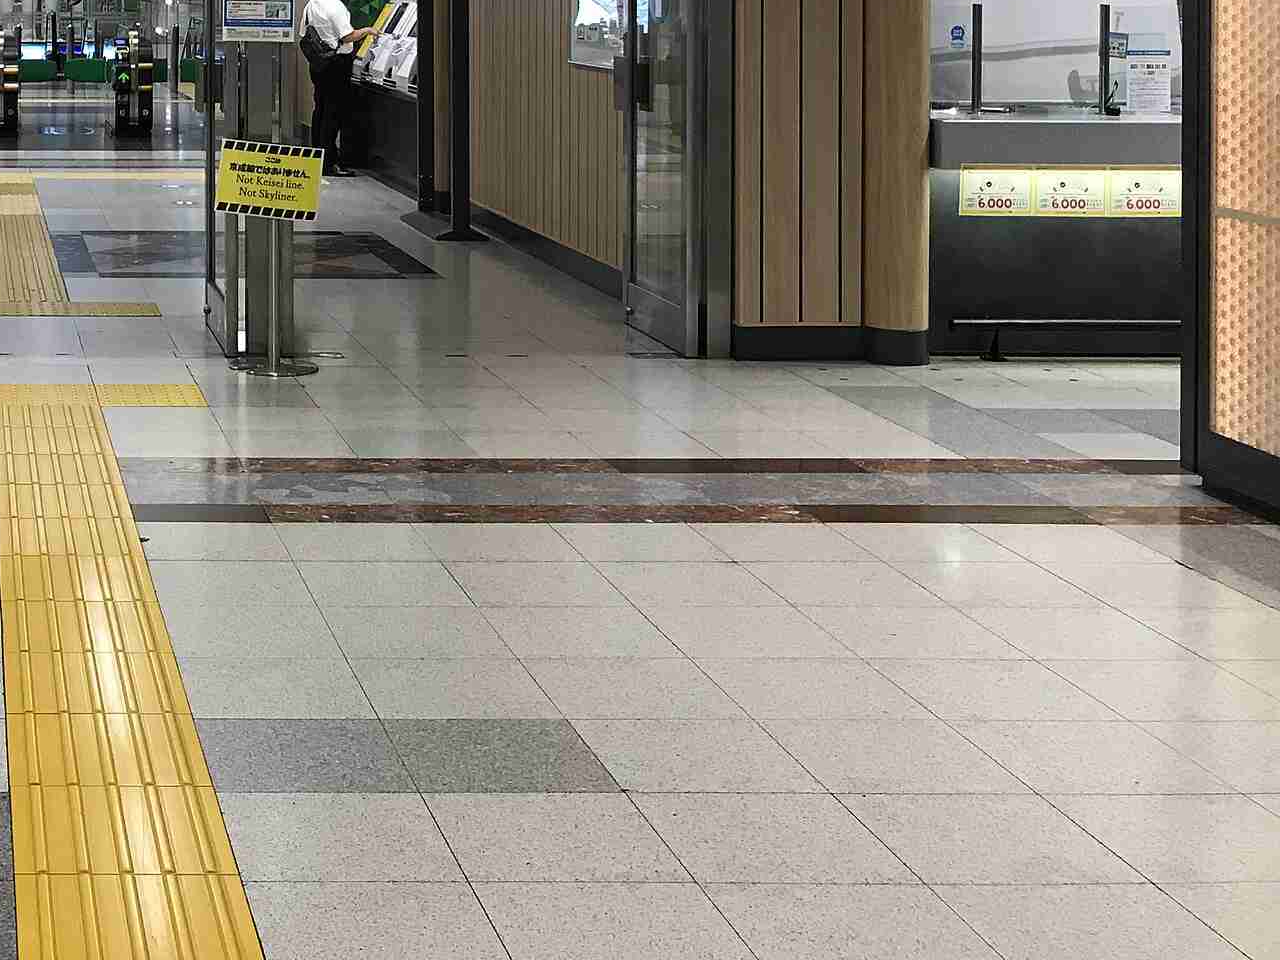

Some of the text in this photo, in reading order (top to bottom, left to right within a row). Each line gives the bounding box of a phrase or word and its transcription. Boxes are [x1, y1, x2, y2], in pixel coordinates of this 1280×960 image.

[236, 173, 254, 185] Not
[256, 175, 284, 189] Keisei
[239, 187, 259, 198] Not
